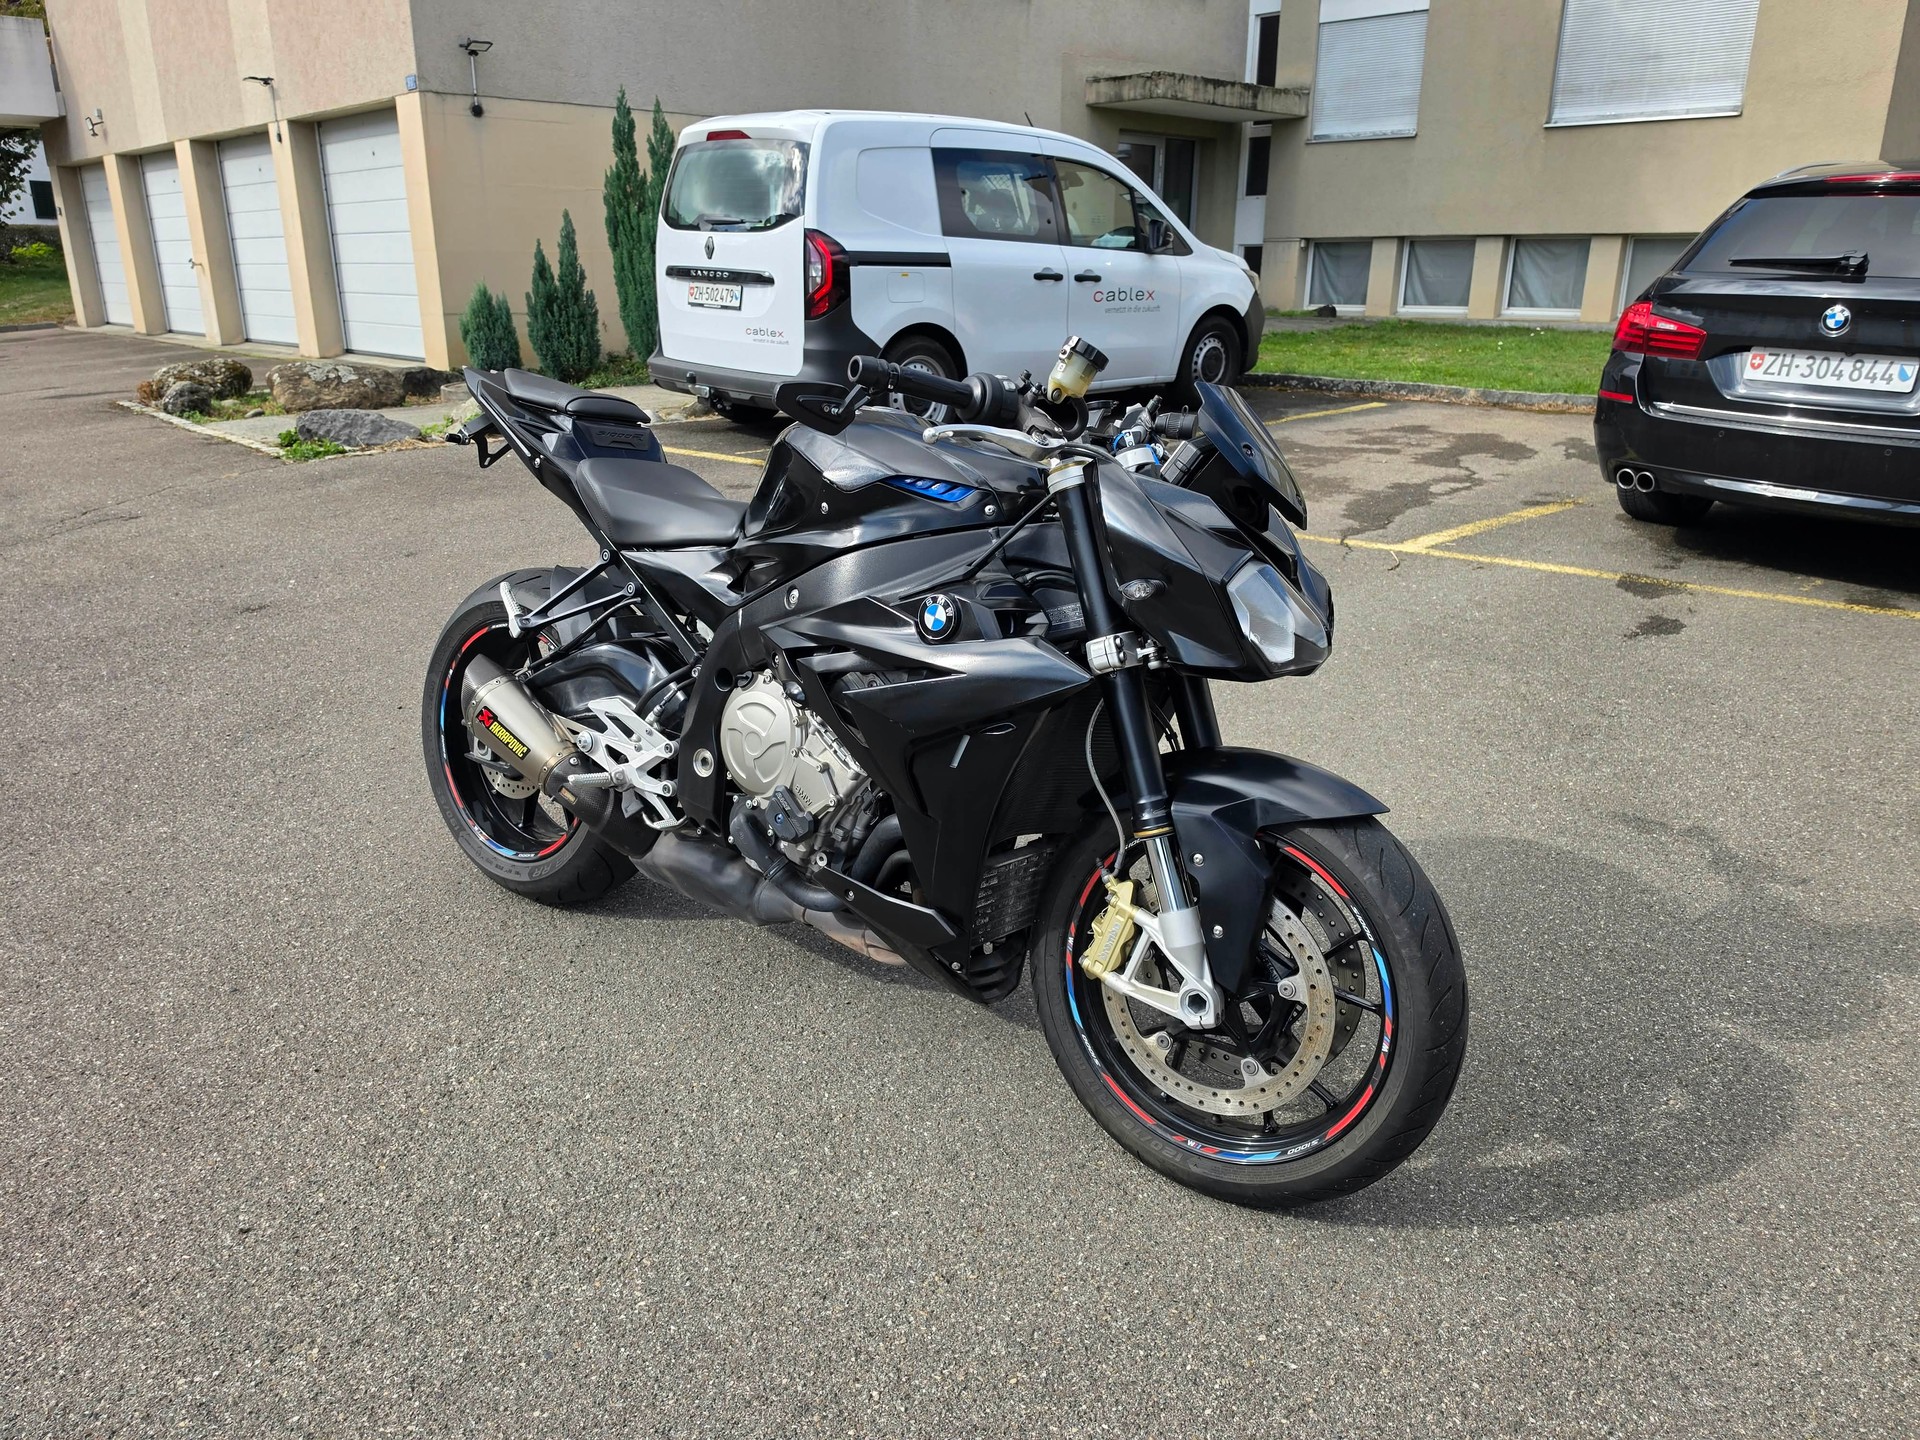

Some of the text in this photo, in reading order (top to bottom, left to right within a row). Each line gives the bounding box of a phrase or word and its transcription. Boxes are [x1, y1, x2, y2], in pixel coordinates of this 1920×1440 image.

[1093, 287, 1156, 303] cablex
[745, 327, 784, 339] cablex
[925, 595, 954, 617] BMW
[489, 721, 528, 758] AKRAPOVIC
[1350, 904, 1375, 942] S1000
[1287, 1138, 1320, 1155] S1000
